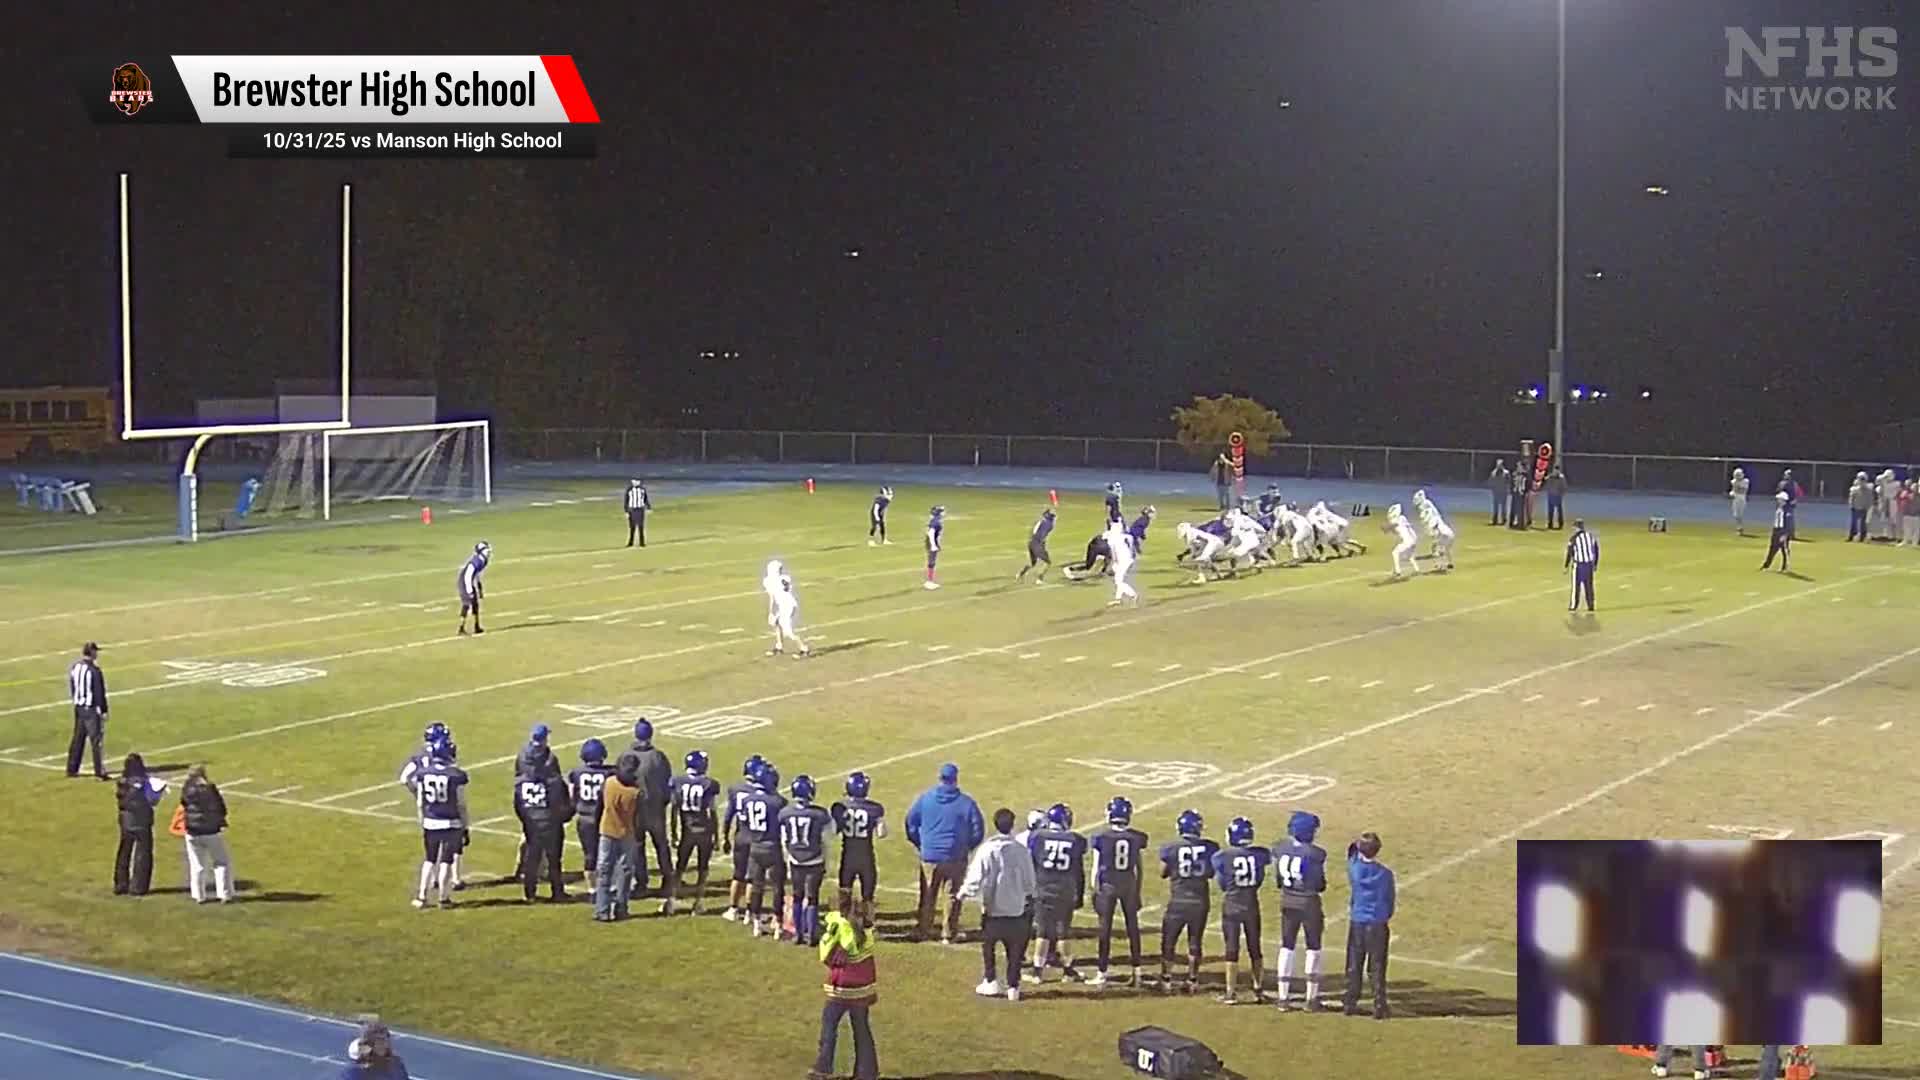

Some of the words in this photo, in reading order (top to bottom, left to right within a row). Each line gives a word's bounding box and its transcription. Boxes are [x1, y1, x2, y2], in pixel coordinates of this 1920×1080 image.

[681, 783, 704, 812] 10
[746, 801, 767, 831] 12
[842, 808, 868, 838] 32
[787, 816, 812, 848] 17
[1043, 839, 1073, 871] 75
[1114, 839, 1129, 870] 8
[1177, 846, 1206, 877] 65
[1232, 855, 1256, 888] 21
